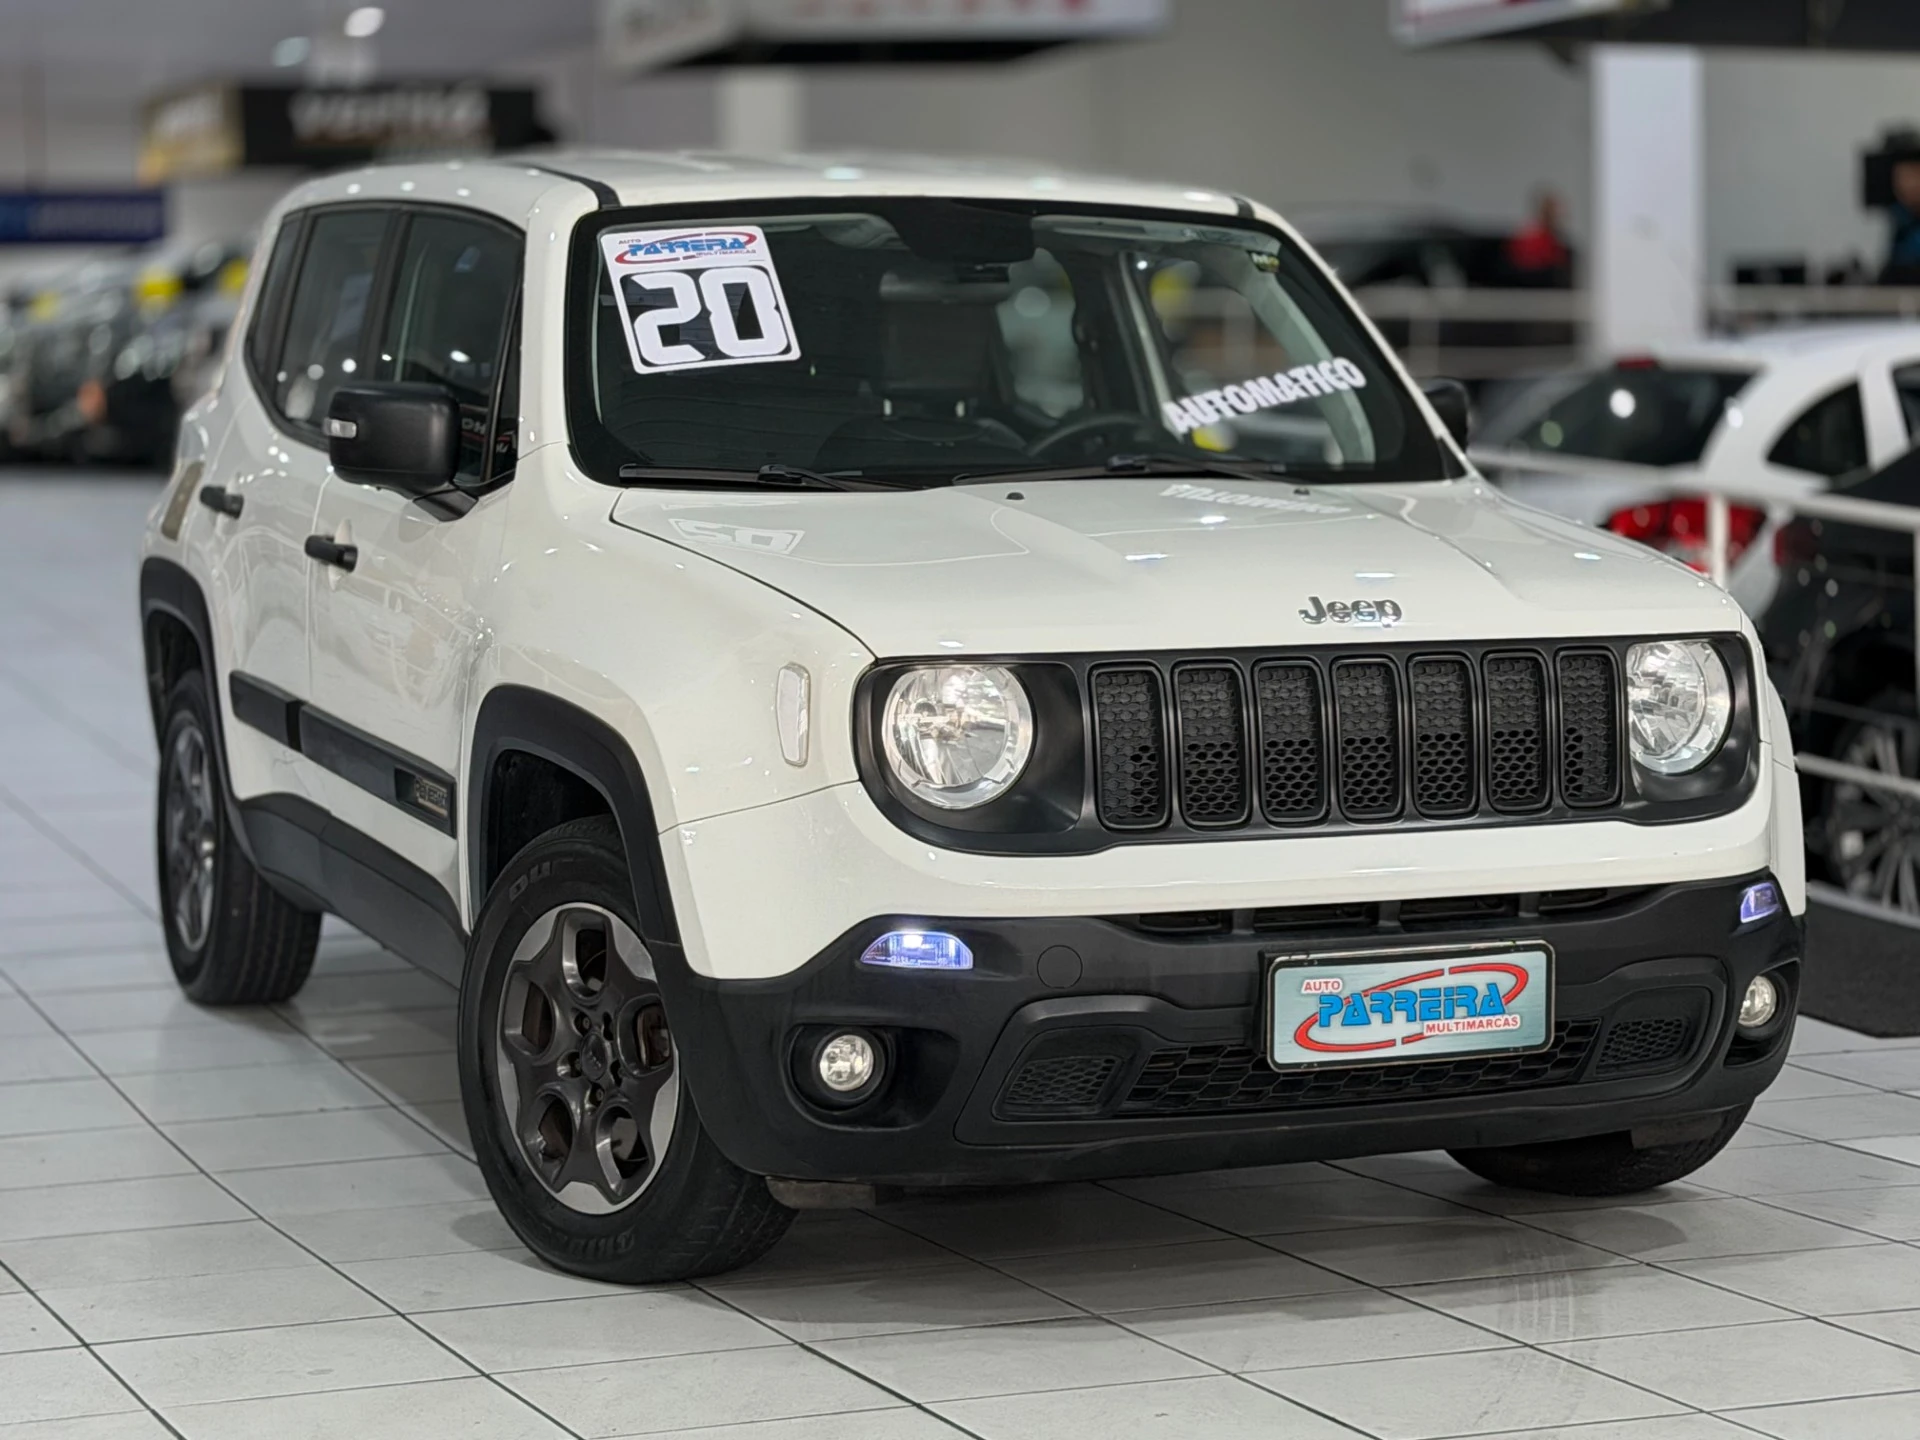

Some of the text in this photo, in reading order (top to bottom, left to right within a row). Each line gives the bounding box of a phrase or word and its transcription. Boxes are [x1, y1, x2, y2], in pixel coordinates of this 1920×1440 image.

[631, 267, 788, 366] 20
[1162, 357, 1367, 434] AUTOMATICO
[1298, 595, 1402, 628] Jeep
[1303, 979, 1341, 993] AUTO
[1318, 982, 1507, 1028] PARREIRA
[1424, 1016, 1519, 1034] MULTIMARCAS
